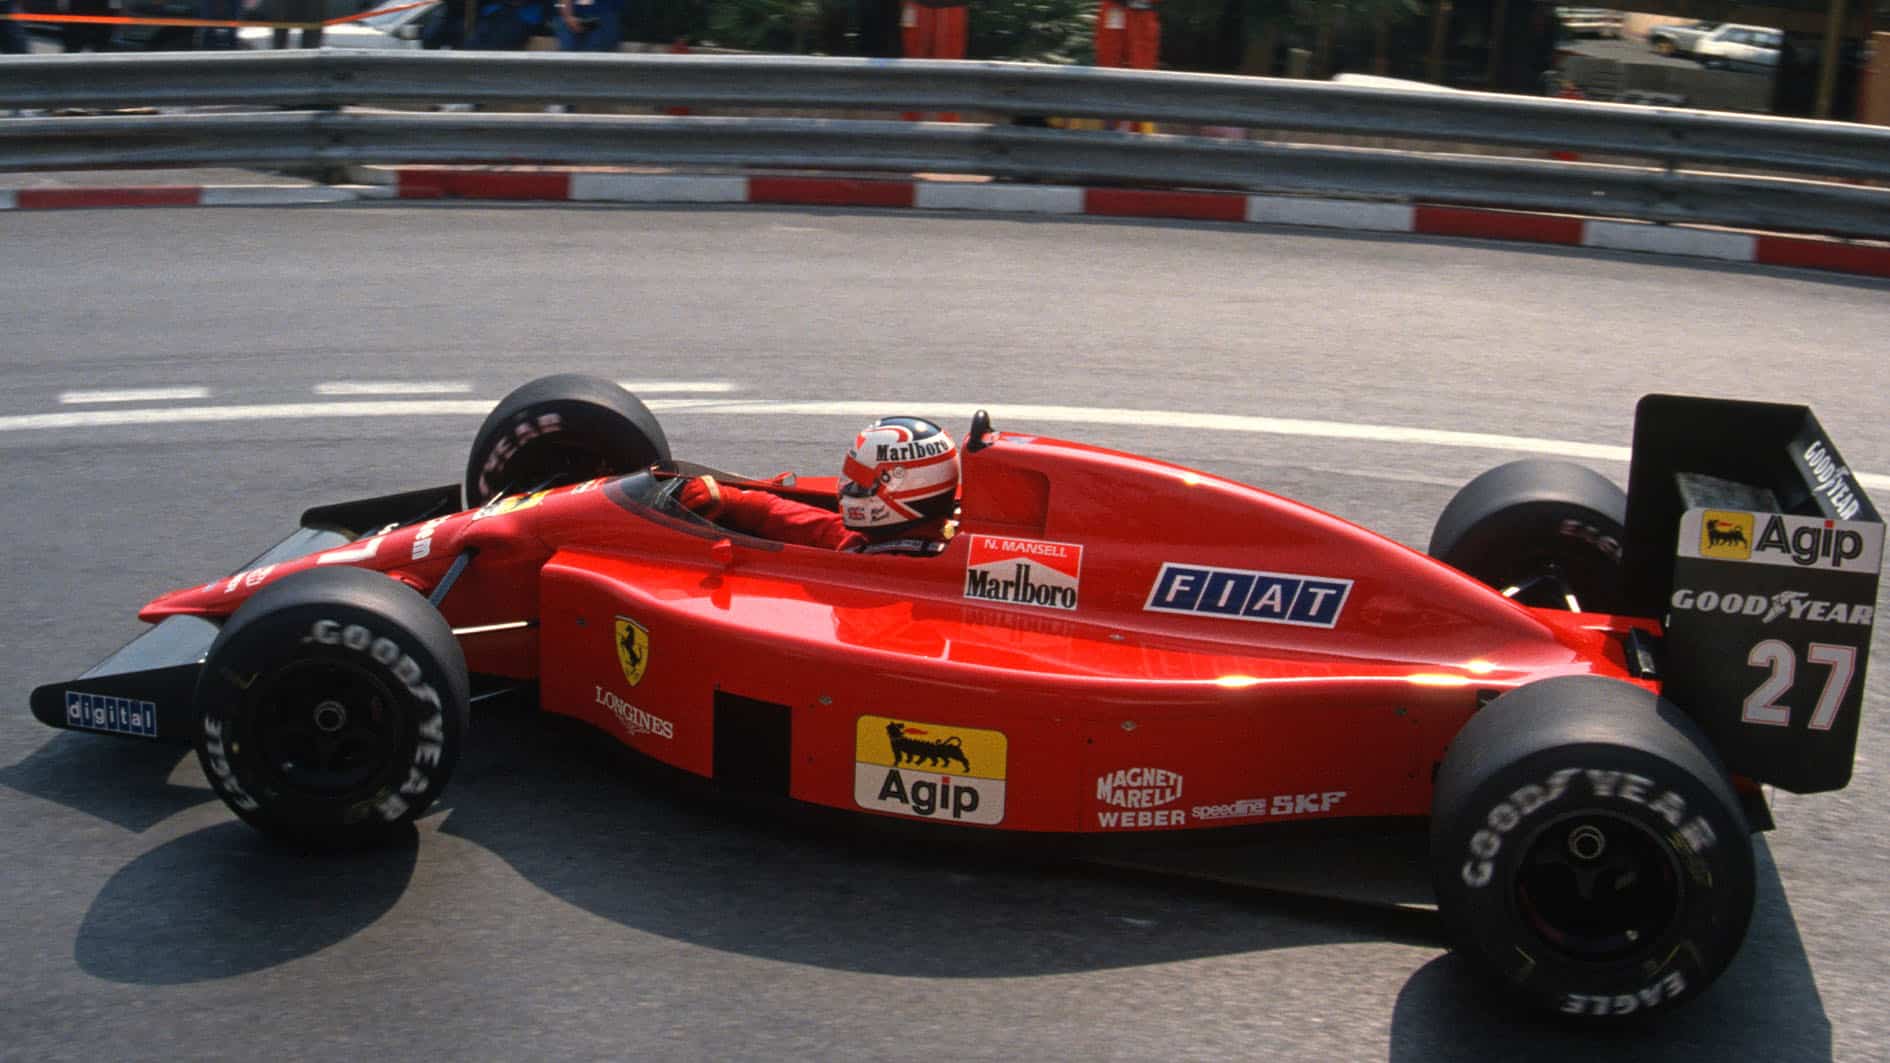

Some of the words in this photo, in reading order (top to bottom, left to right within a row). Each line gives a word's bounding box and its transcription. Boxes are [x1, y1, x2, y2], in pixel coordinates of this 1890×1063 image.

[876, 439, 949, 461] Marlboro
[984, 538, 998, 551] N.
[1002, 539, 1068, 558] MANSELL
[1755, 514, 1863, 567] Agip
[966, 563, 1076, 609] Marlboro
[1164, 573, 1338, 615] FIAT
[1741, 639, 1857, 730] 27
[68, 692, 153, 730] digital
[595, 685, 673, 739] LONGINES
[877, 769, 981, 819] Agip
[1097, 767, 1183, 801] MAGNETI
[1097, 810, 1186, 828] WEBER
[1191, 799, 1267, 820] speedline
[1270, 792, 1347, 816] SKF
